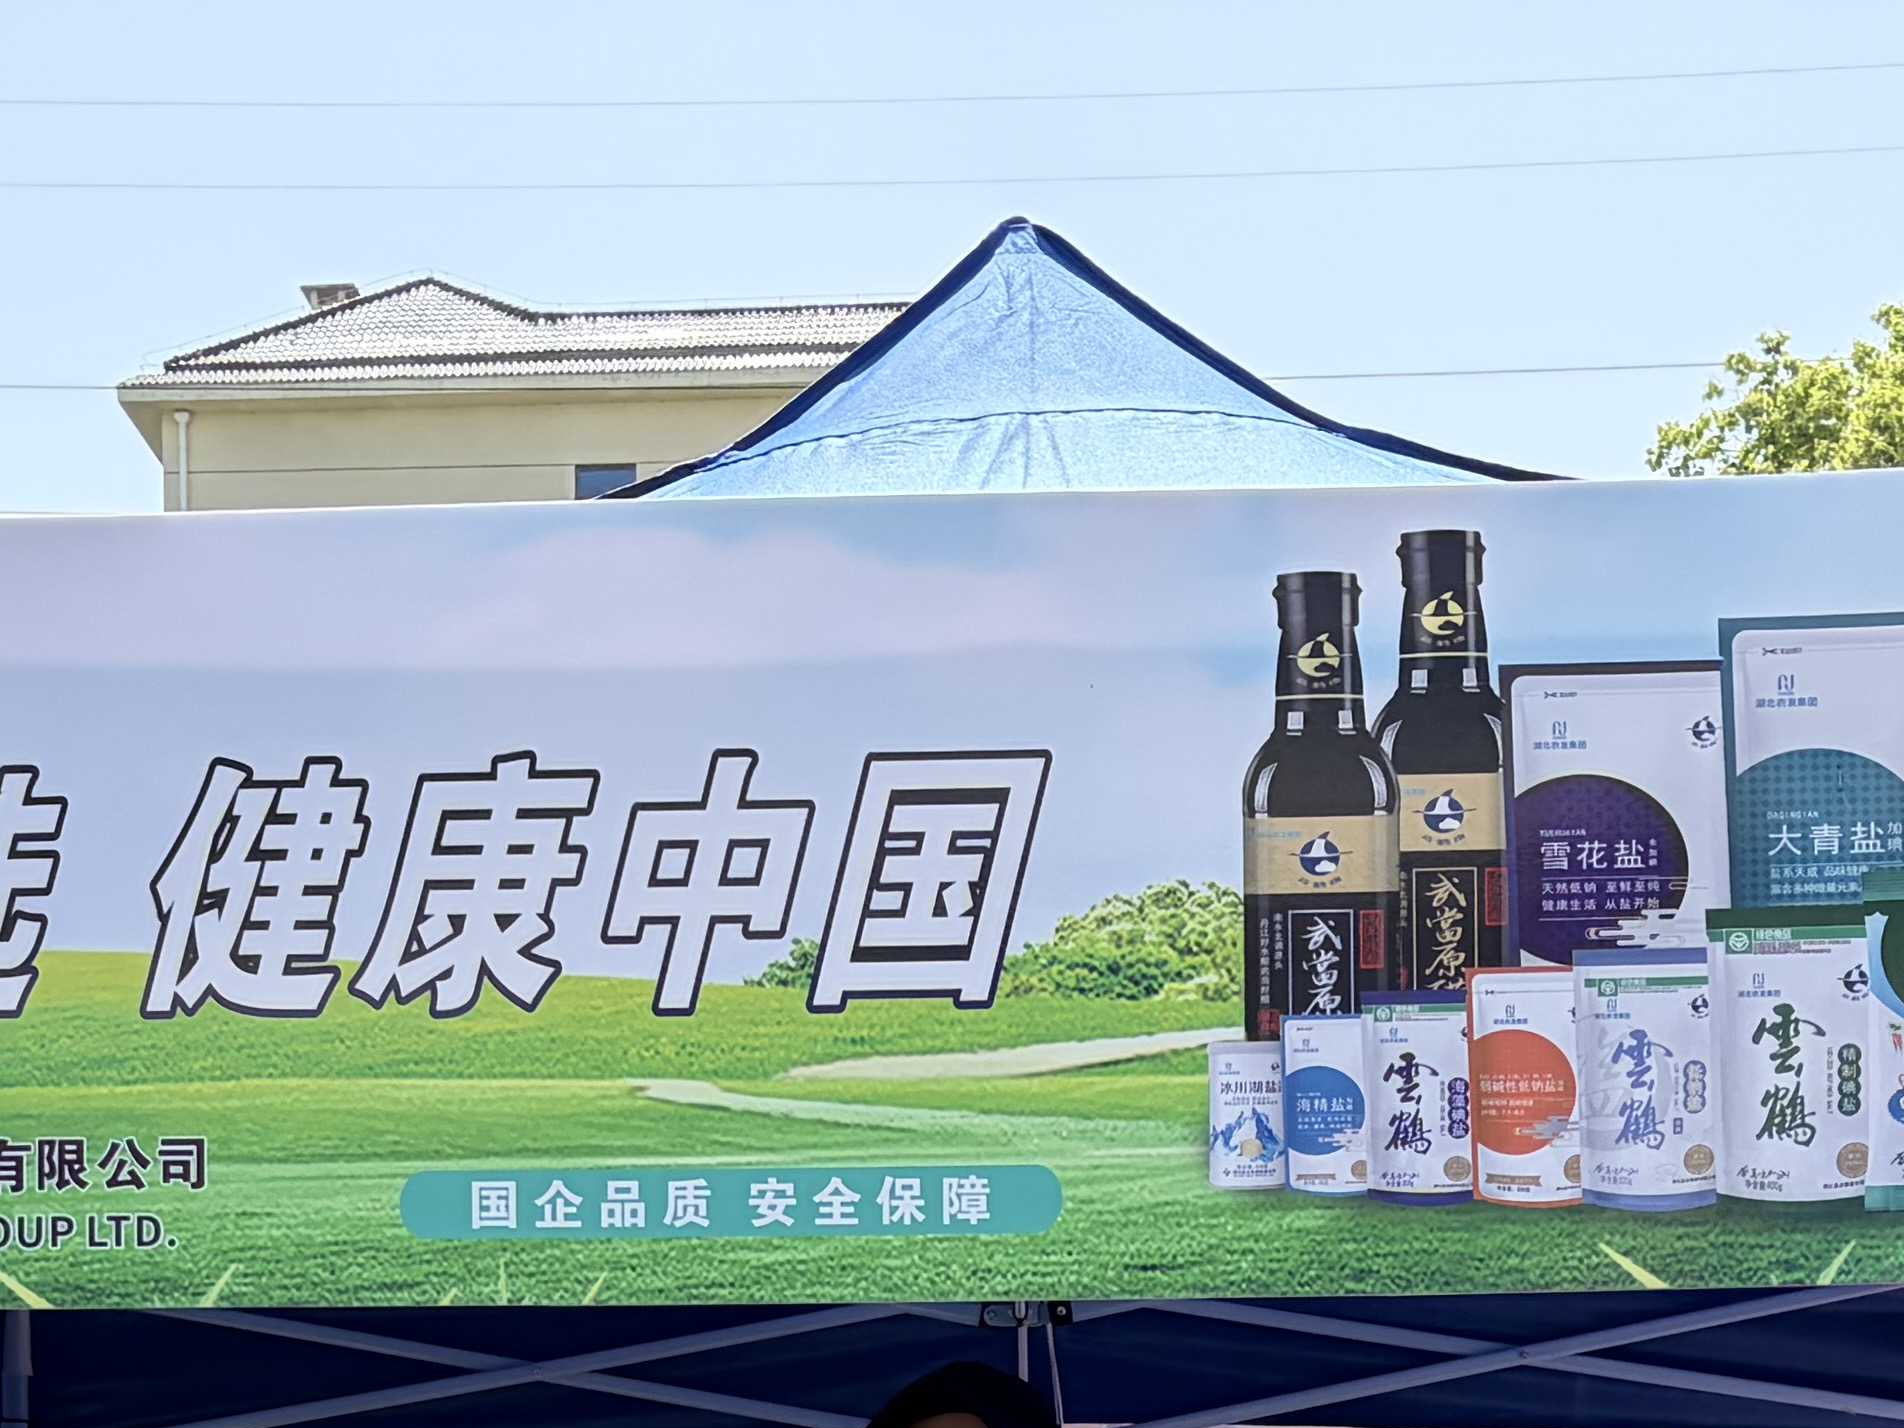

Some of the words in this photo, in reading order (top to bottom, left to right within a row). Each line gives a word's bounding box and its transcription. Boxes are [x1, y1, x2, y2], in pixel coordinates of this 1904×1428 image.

[1540, 840, 1645, 871] 雪花盐
[1768, 821, 1886, 856] 大青盐
[140, 748, 1053, 1020] 健康中国
[1542, 881, 1597, 894] 天然低钠
[1542, 898, 1597, 911] 健康生活
[1604, 897, 1660, 910] 从盐开始
[471, 1179, 712, 1231] 国企品质
[748, 1173, 993, 1228] 安全保障
[86, 1213, 180, 1249] LTD.
